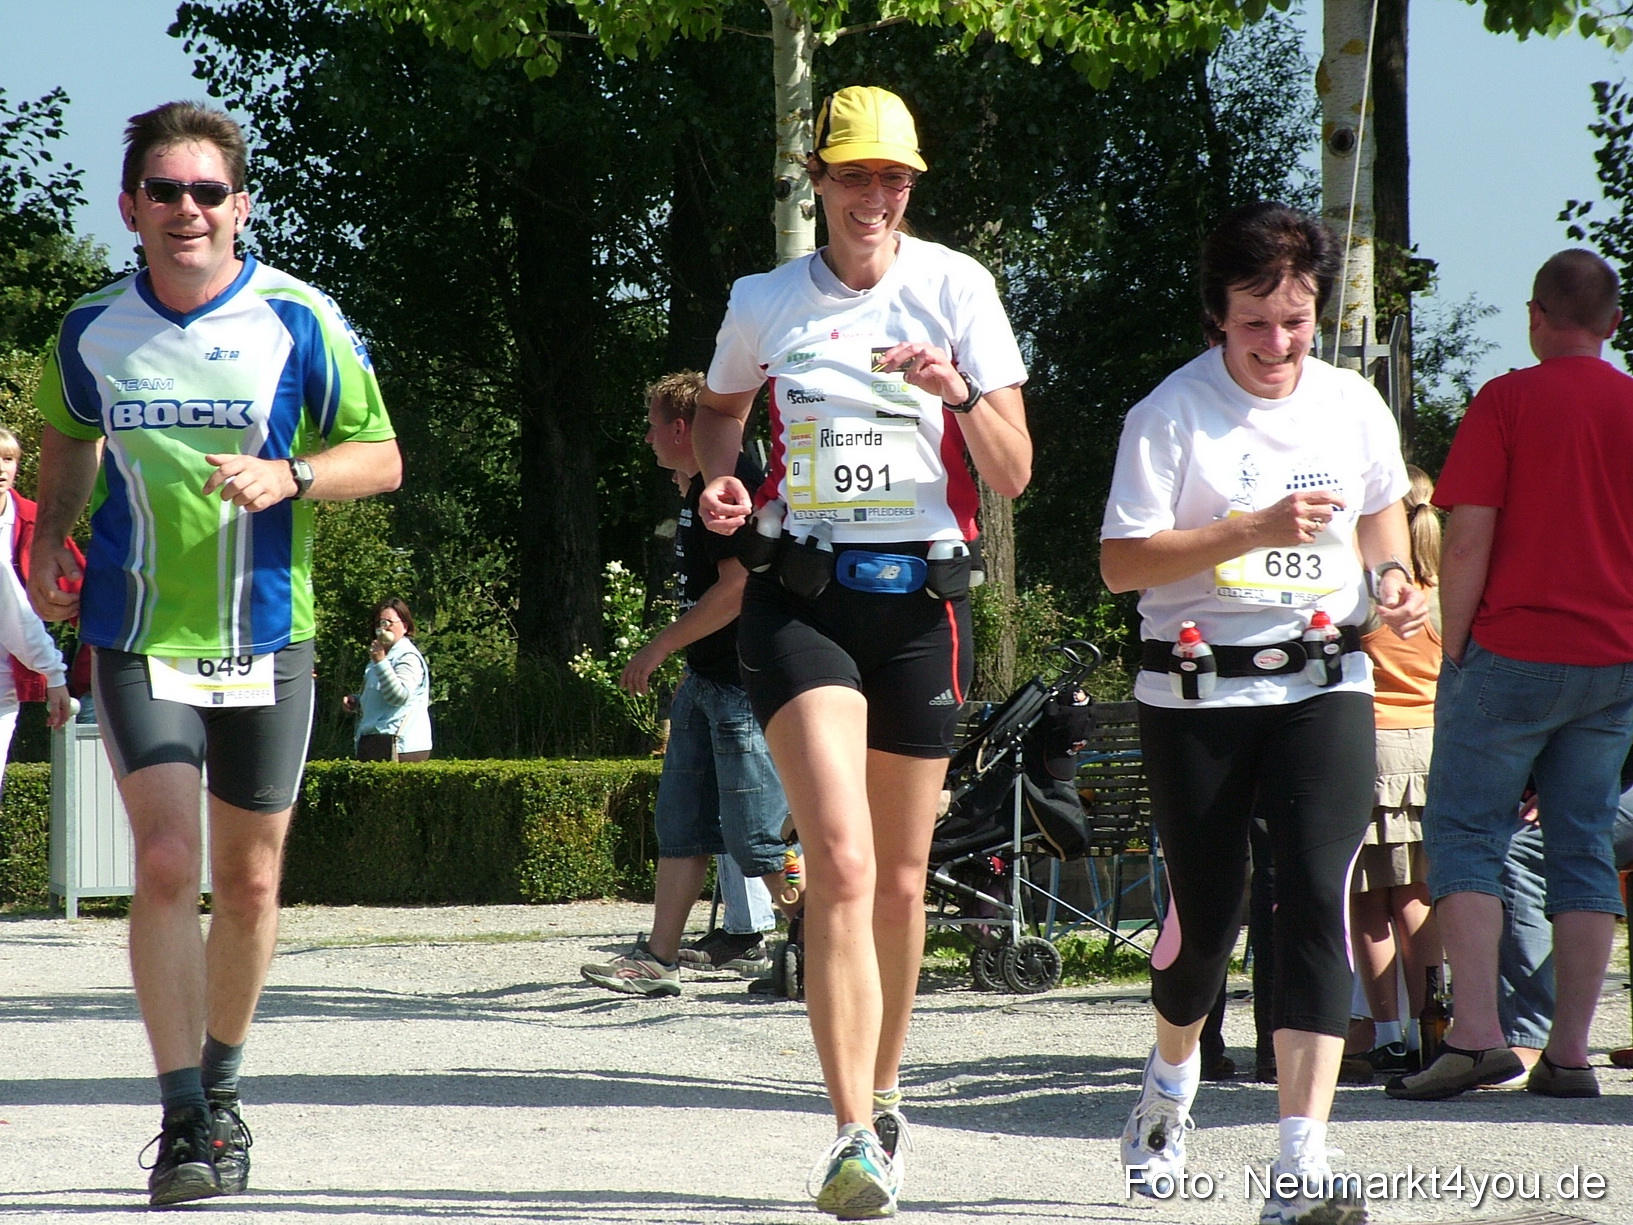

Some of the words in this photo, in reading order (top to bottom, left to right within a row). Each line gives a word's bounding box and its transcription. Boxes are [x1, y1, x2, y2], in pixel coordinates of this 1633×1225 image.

[115, 378, 174, 391] TEAM
[111, 399, 254, 431] BOCK
[820, 428, 883, 448] Ricarda
[834, 464, 891, 493] 991
[794, 509, 838, 521] BOCK
[868, 507, 915, 517] PFLEIDERER
[1265, 550, 1322, 580] 683
[197, 655, 253, 677] 649
